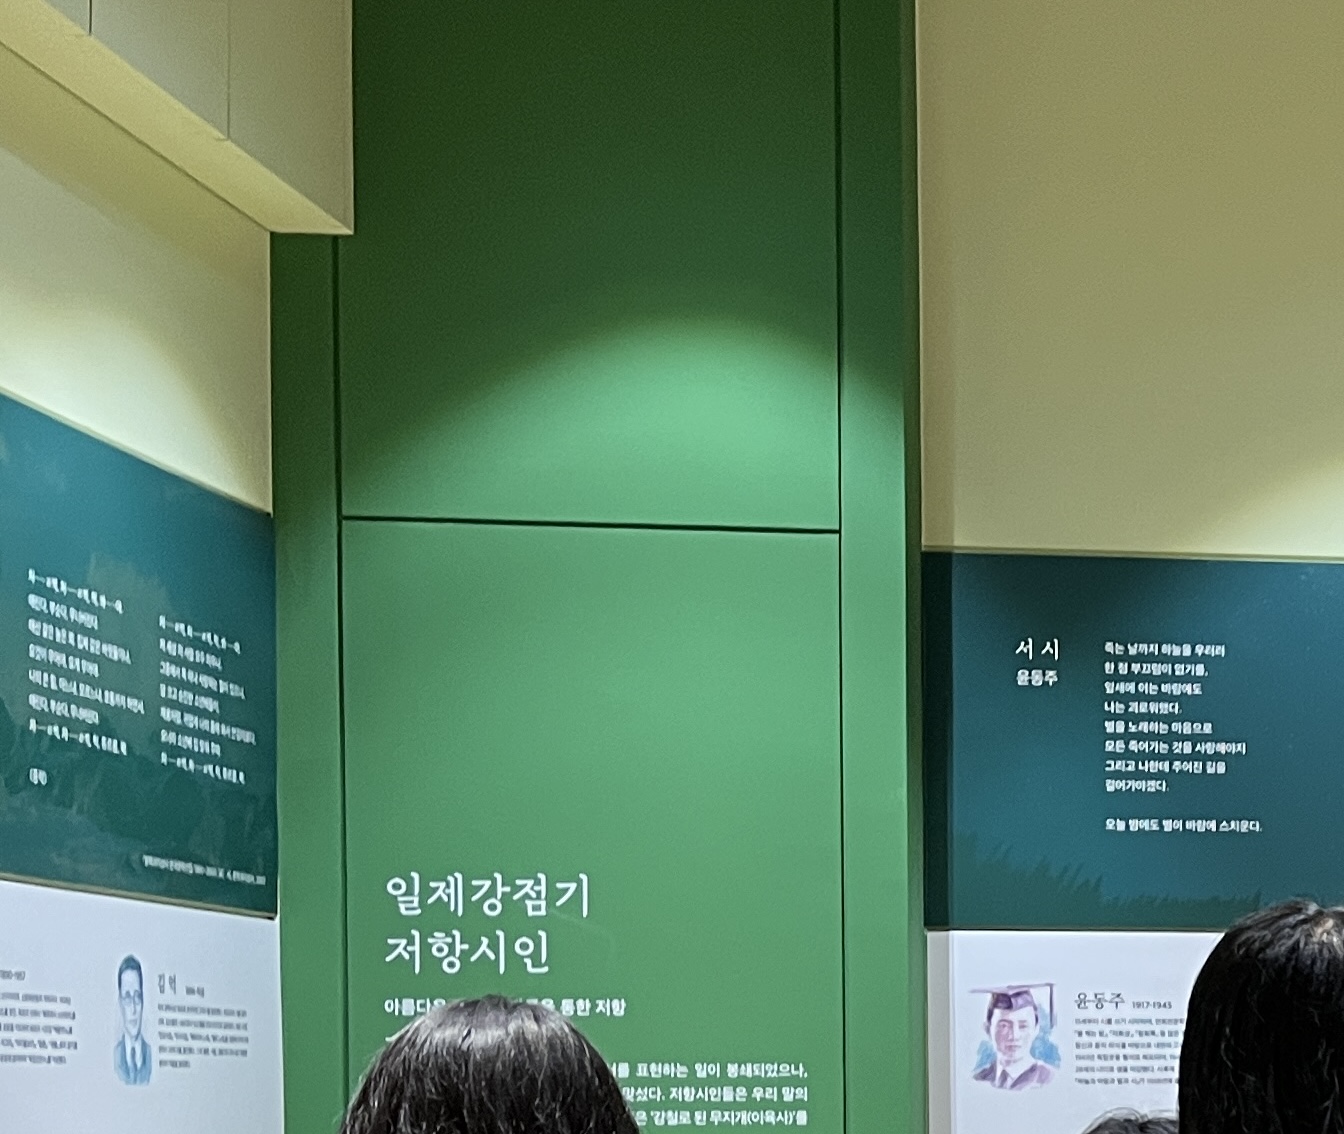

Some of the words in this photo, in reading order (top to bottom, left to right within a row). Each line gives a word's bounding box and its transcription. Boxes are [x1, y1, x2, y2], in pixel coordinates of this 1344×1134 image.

[1015, 637, 1032, 659] 서
[1041, 638, 1058, 660] 시
[1016, 669, 1057, 685] 윤동주
[1104, 700, 1125, 713] 나는
[387, 872, 587, 916] 일제강점기
[385, 929, 548, 973] 저항시인
[560, 998, 591, 1016] 통한
[595, 998, 626, 1016] 저항
[1074, 992, 1125, 1009] 윤동주
[636, 1062, 688, 1077] 표현하는
[694, 1062, 720, 1078] 일이
[669, 1086, 747, 1101] 저항시인들은
[751, 1086, 777, 1101] 우리
[781, 1086, 807, 1101] 말의
[694, 1110, 706, 1125] 된
